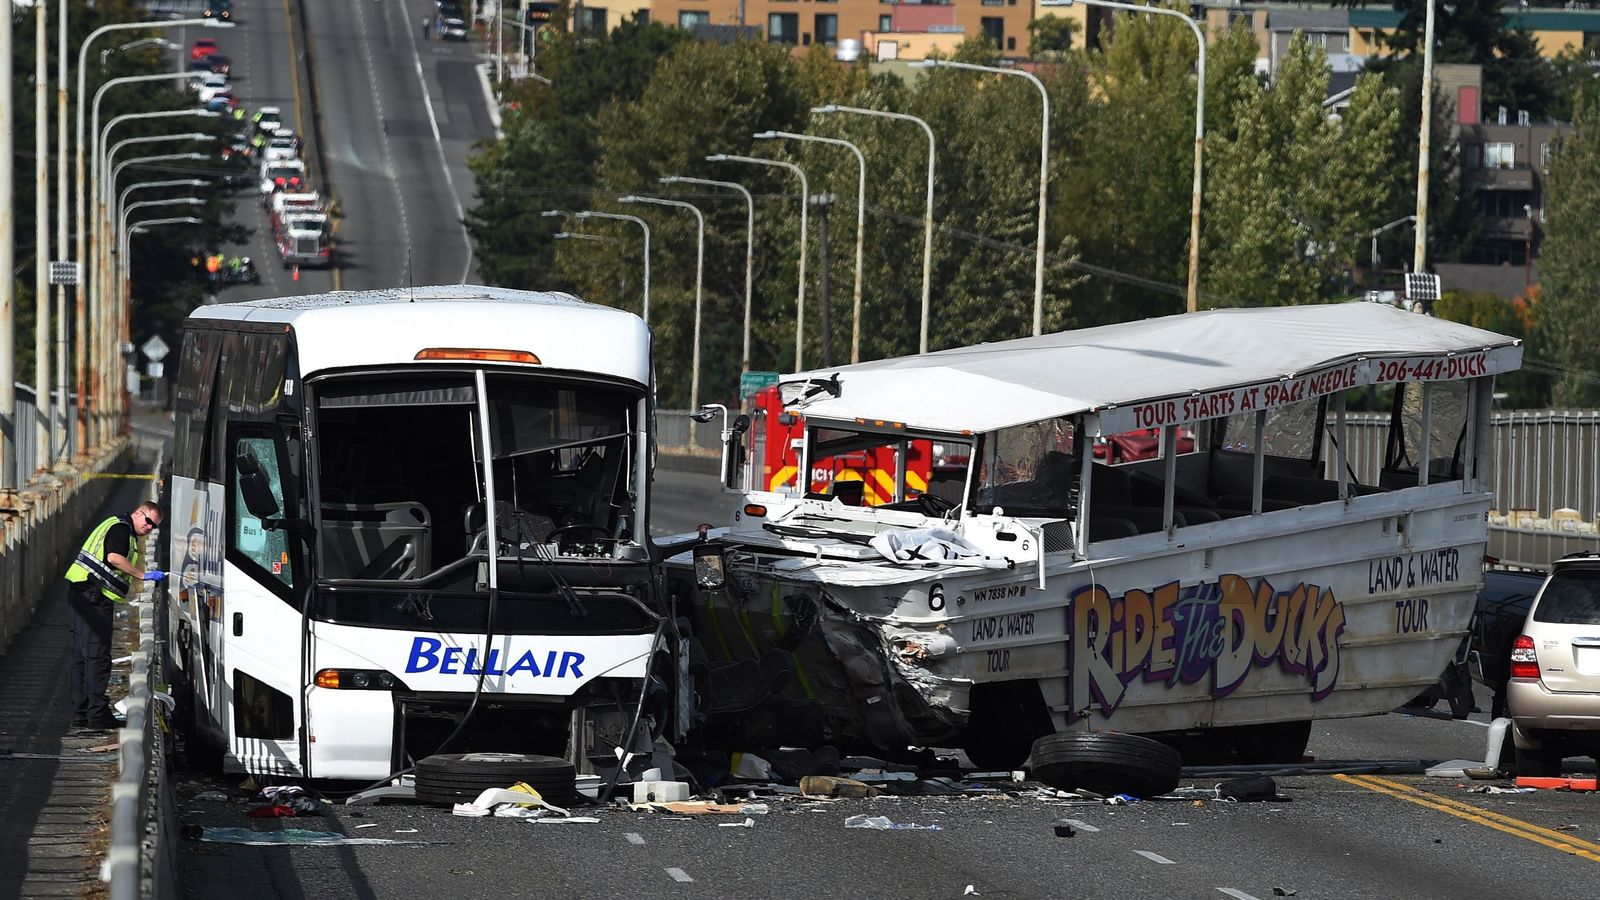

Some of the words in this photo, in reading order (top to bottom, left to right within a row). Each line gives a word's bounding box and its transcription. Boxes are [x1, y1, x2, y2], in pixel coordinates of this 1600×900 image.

[1377, 353, 1487, 382] 206-441-DUCK
[1133, 404, 1176, 428] TOUR
[1183, 391, 1235, 421] STARTS
[1240, 387, 1260, 411] AT
[1264, 378, 1306, 407] SPACE
[1308, 365, 1357, 397] NEEDLE
[735, 510, 741, 521] 6
[243, 525, 257, 536] Bus
[1022, 539, 1029, 551] 6
[1368, 556, 1403, 594] LAND
[1406, 555, 1415, 588] &
[1420, 547, 1459, 587] WATER
[928, 583, 945, 612] 6
[974, 590, 987, 603] WN
[1007, 585, 1019, 598] NP
[971, 617, 997, 641] LAND
[1006, 613, 1035, 638] WATER
[1395, 599, 1429, 634] TOUR
[1215, 574, 1346, 699] DUCKS
[404, 636, 586, 679] BELLAIR
[987, 649, 1010, 673] TOUR
